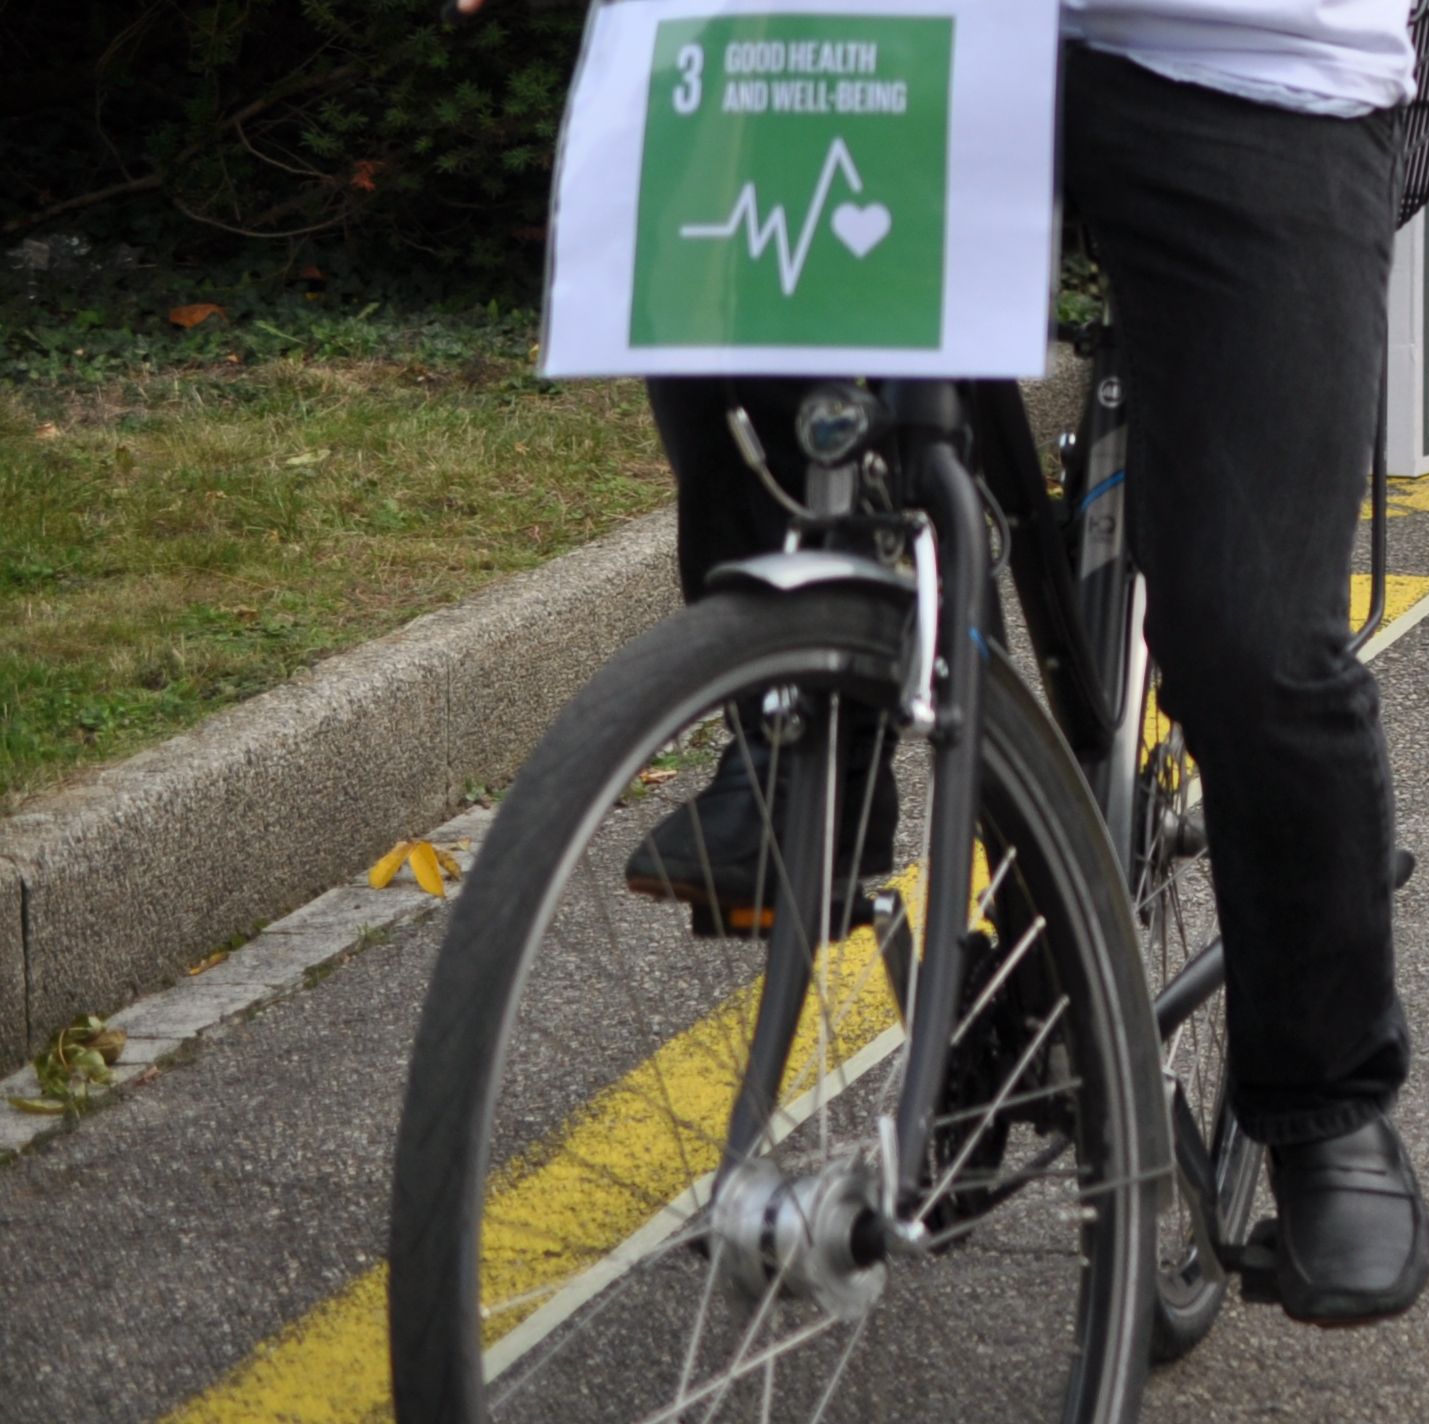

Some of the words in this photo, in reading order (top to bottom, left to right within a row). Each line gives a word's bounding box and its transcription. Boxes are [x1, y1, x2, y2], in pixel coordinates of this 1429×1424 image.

[724, 41, 785, 74] GOOD
[787, 41, 878, 74] HEALTH
[673, 44, 704, 116] 3
[722, 79, 769, 113] AND
[771, 79, 907, 114] WELL-BEING
